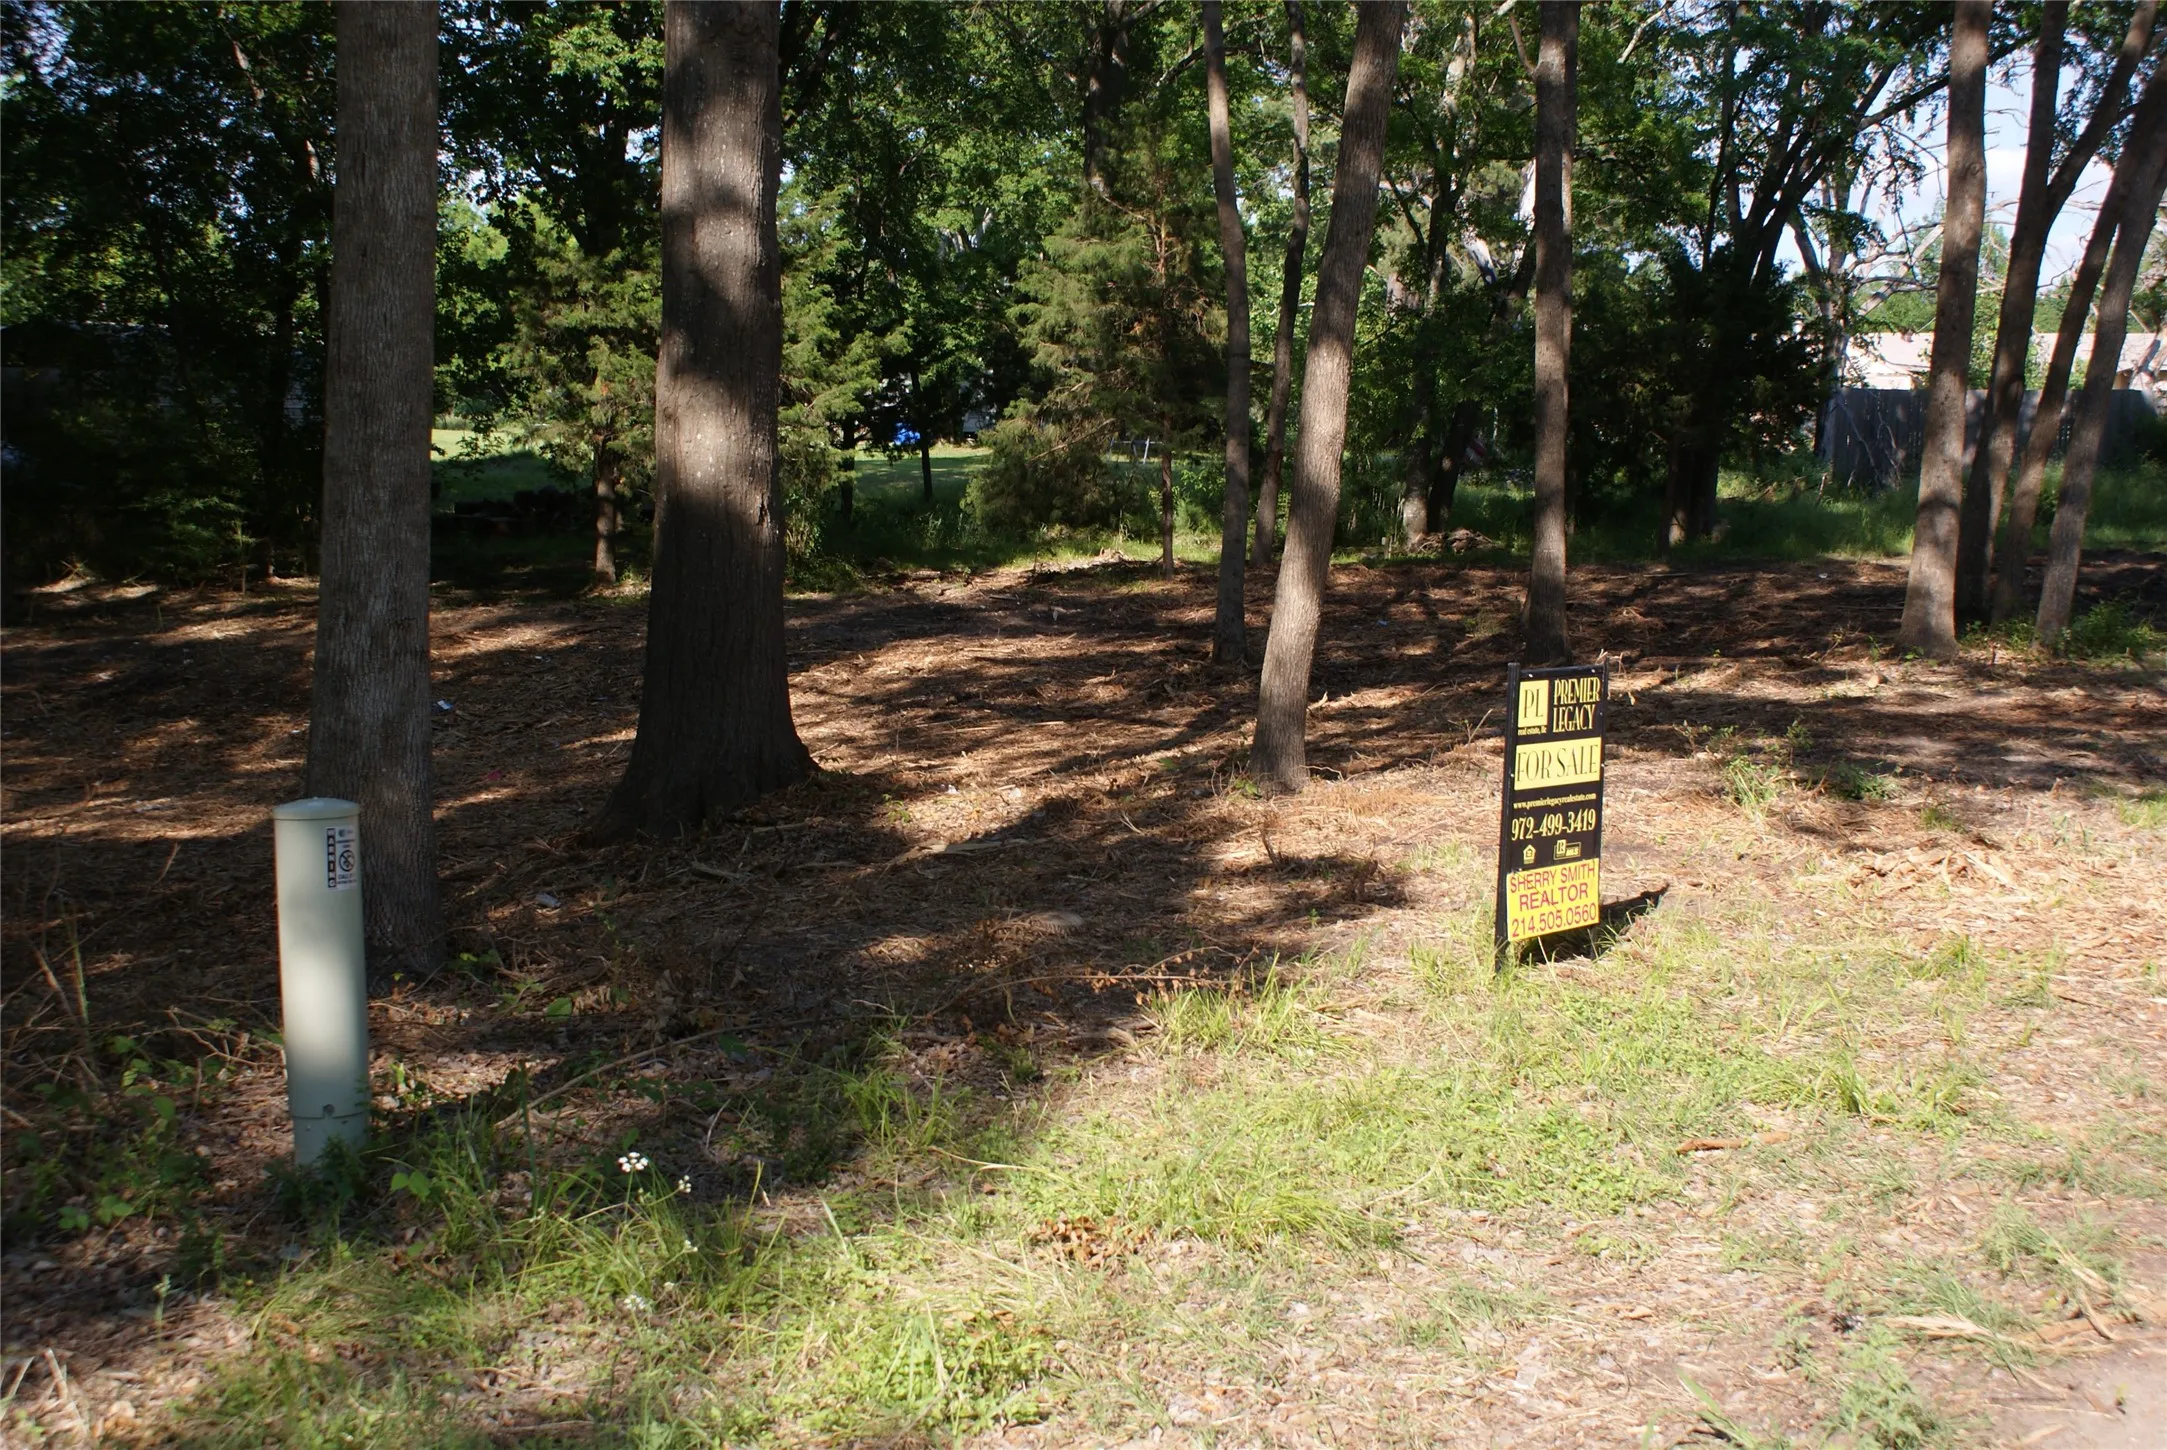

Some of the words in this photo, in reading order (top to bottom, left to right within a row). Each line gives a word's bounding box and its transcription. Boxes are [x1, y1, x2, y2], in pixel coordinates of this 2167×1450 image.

[1524, 688, 1543, 718] PL
[1554, 677, 1600, 705] PREMIER
[1553, 704, 1595, 732] LEGACY
[1517, 749, 1552, 782] FOR
[1556, 744, 1598, 777] SALE
[1513, 793, 1596, 809] www.premierlegacyrealestate.com
[1511, 808, 1596, 841] 972-499-3419
[327, 829, 336, 886] WARNING
[1510, 870, 1557, 893] SHERRY
[1560, 862, 1596, 884] SMITH
[1519, 882, 1588, 912] REALTOR
[1511, 902, 1597, 938] 214.505.0560
